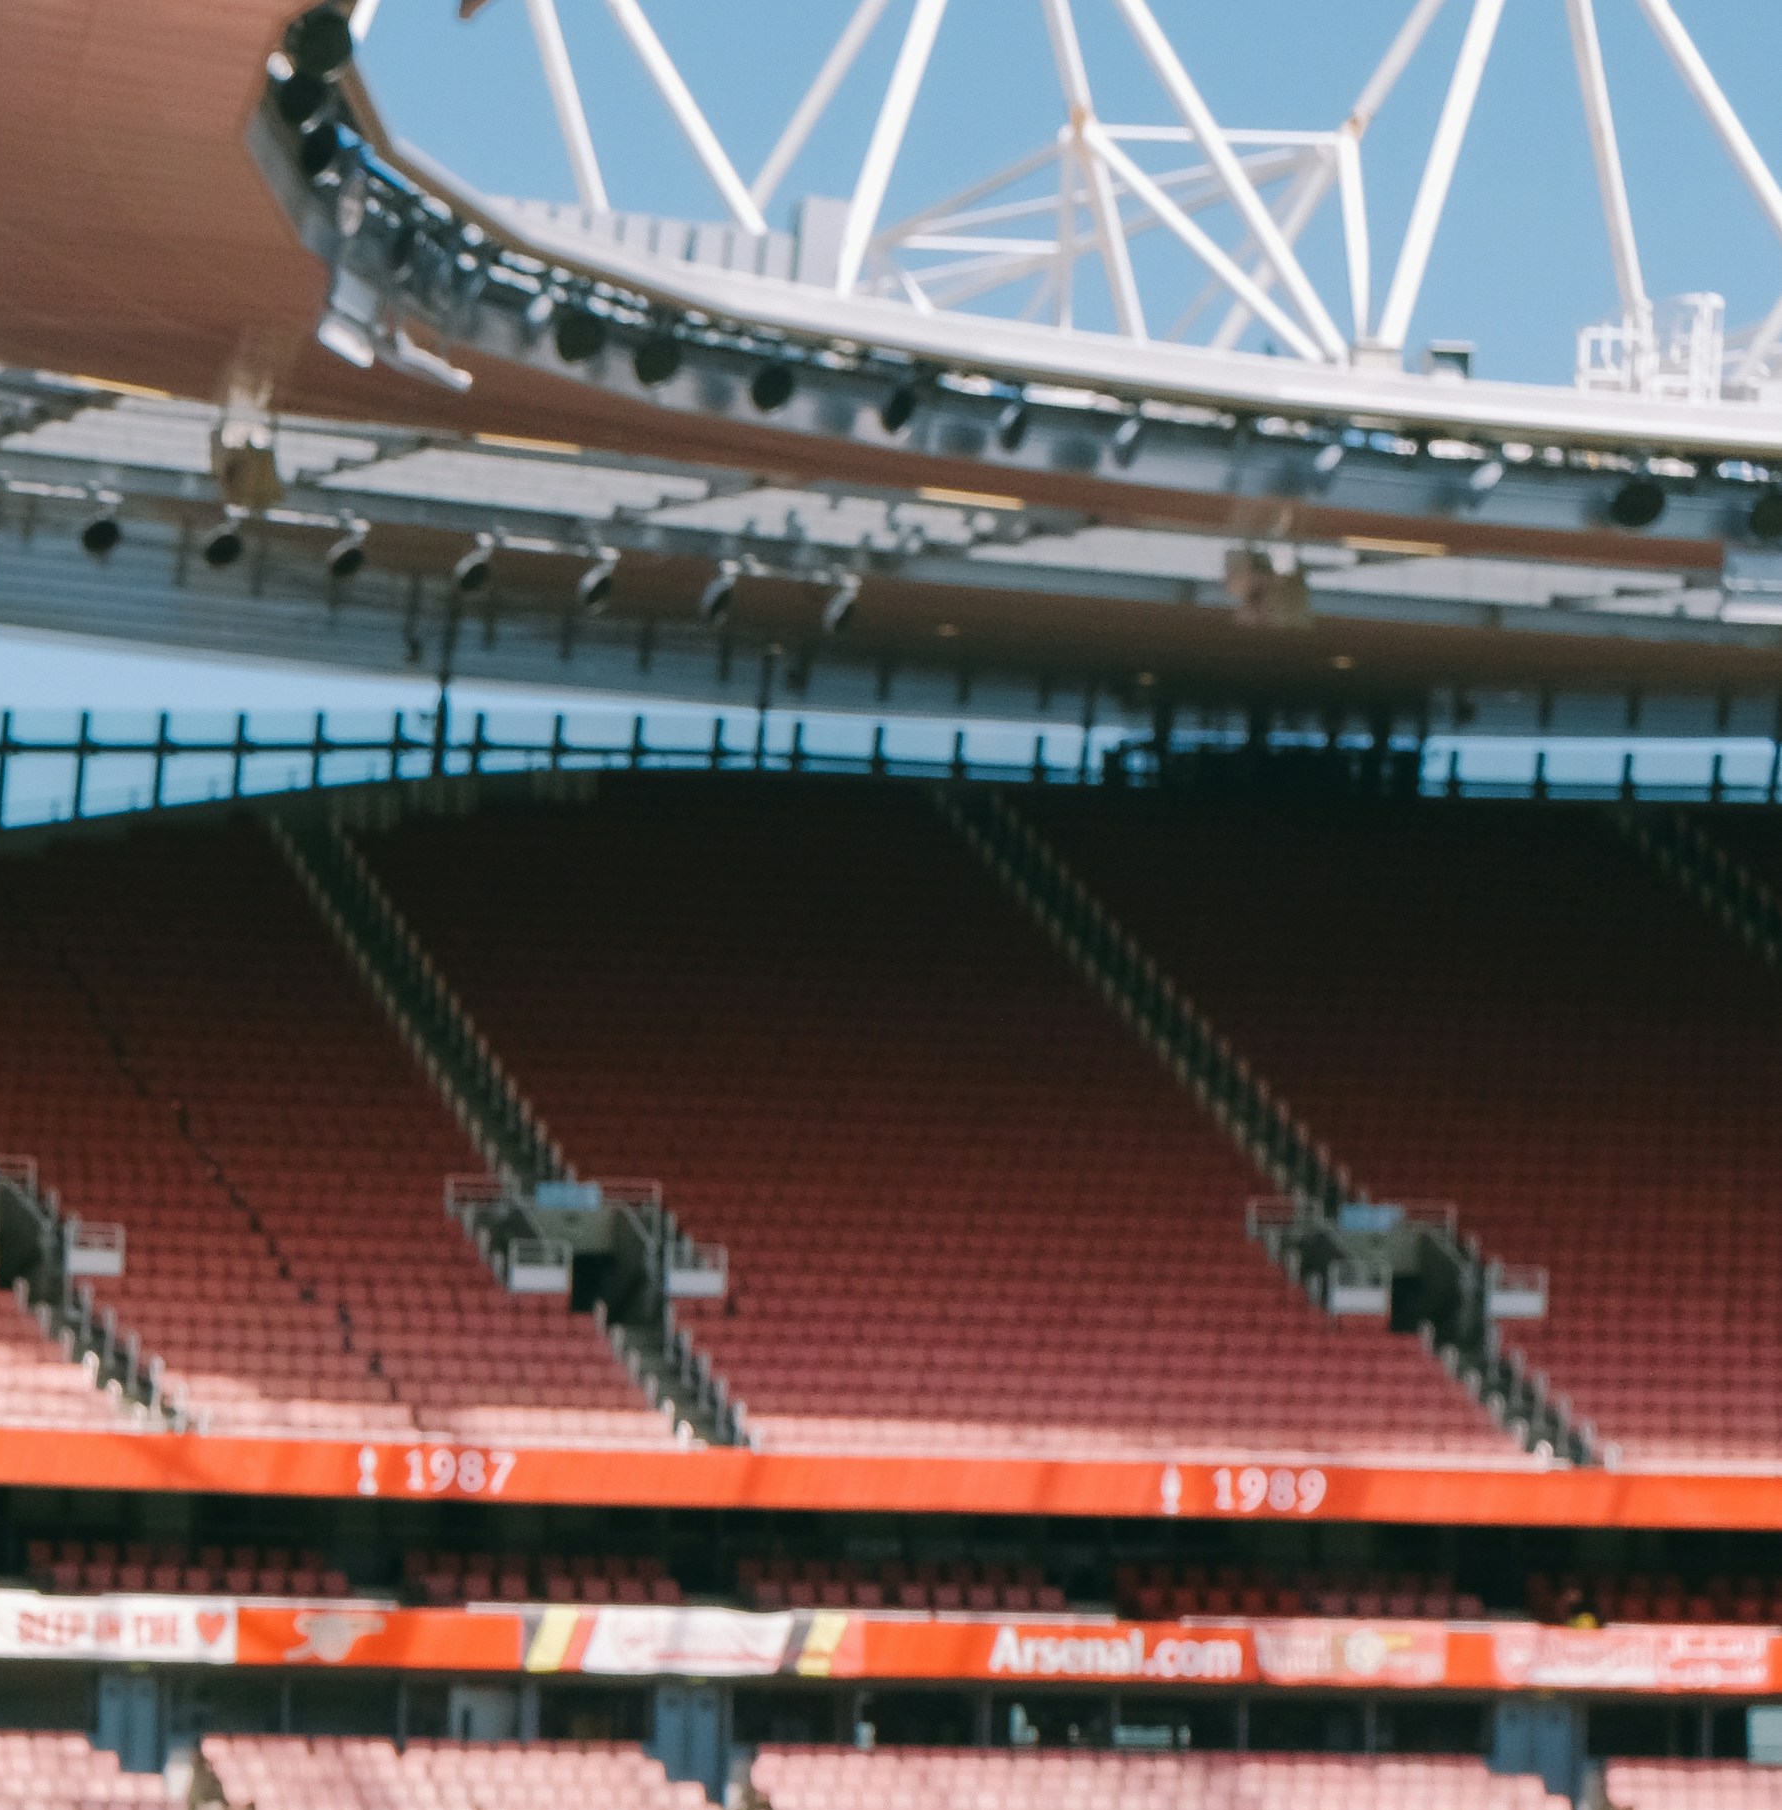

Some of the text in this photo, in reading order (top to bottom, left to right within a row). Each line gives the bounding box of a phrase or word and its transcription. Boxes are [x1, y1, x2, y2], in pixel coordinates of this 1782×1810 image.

[405, 1448, 518, 1495] 1987
[1212, 1466, 1328, 1515] 1989
[987, 1625, 1244, 1678] Arsenal.com
